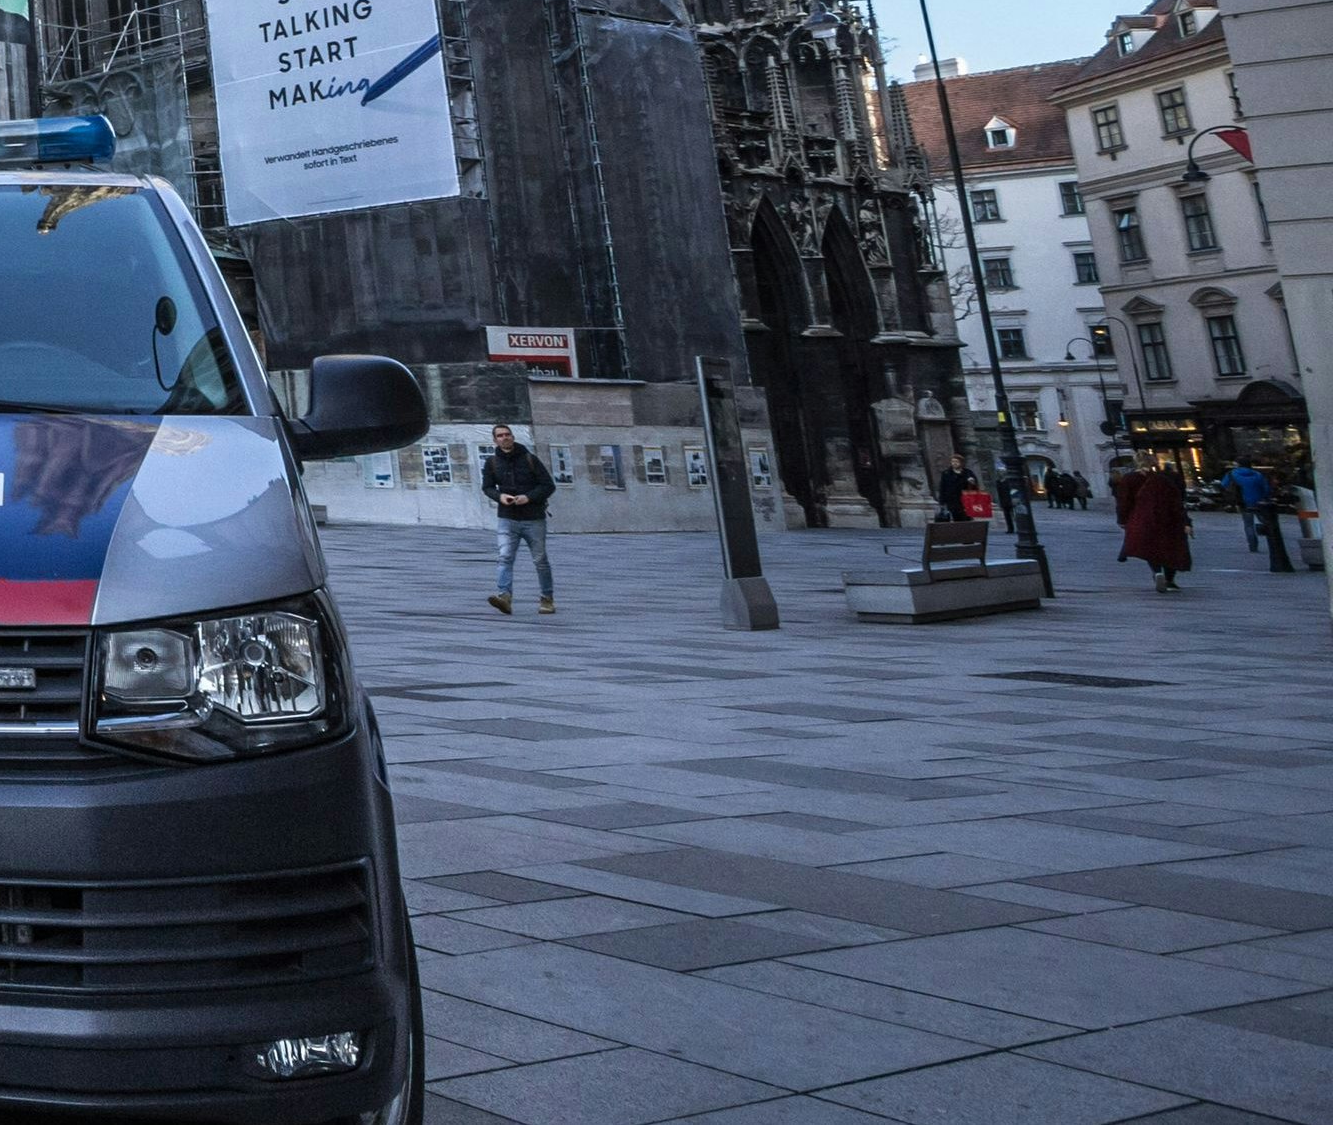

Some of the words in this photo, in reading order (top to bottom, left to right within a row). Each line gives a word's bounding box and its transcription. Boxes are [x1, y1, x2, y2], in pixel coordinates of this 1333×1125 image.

[278, 36, 357, 73] START
[264, 149, 310, 165] Verwandelt
[311, 136, 399, 156] Handgeschriebenes
[303, 159, 329, 170] sofort
[330, 157, 338, 166] in
[339, 154, 358, 164] Text
[510, 335, 565, 347] XERVON
